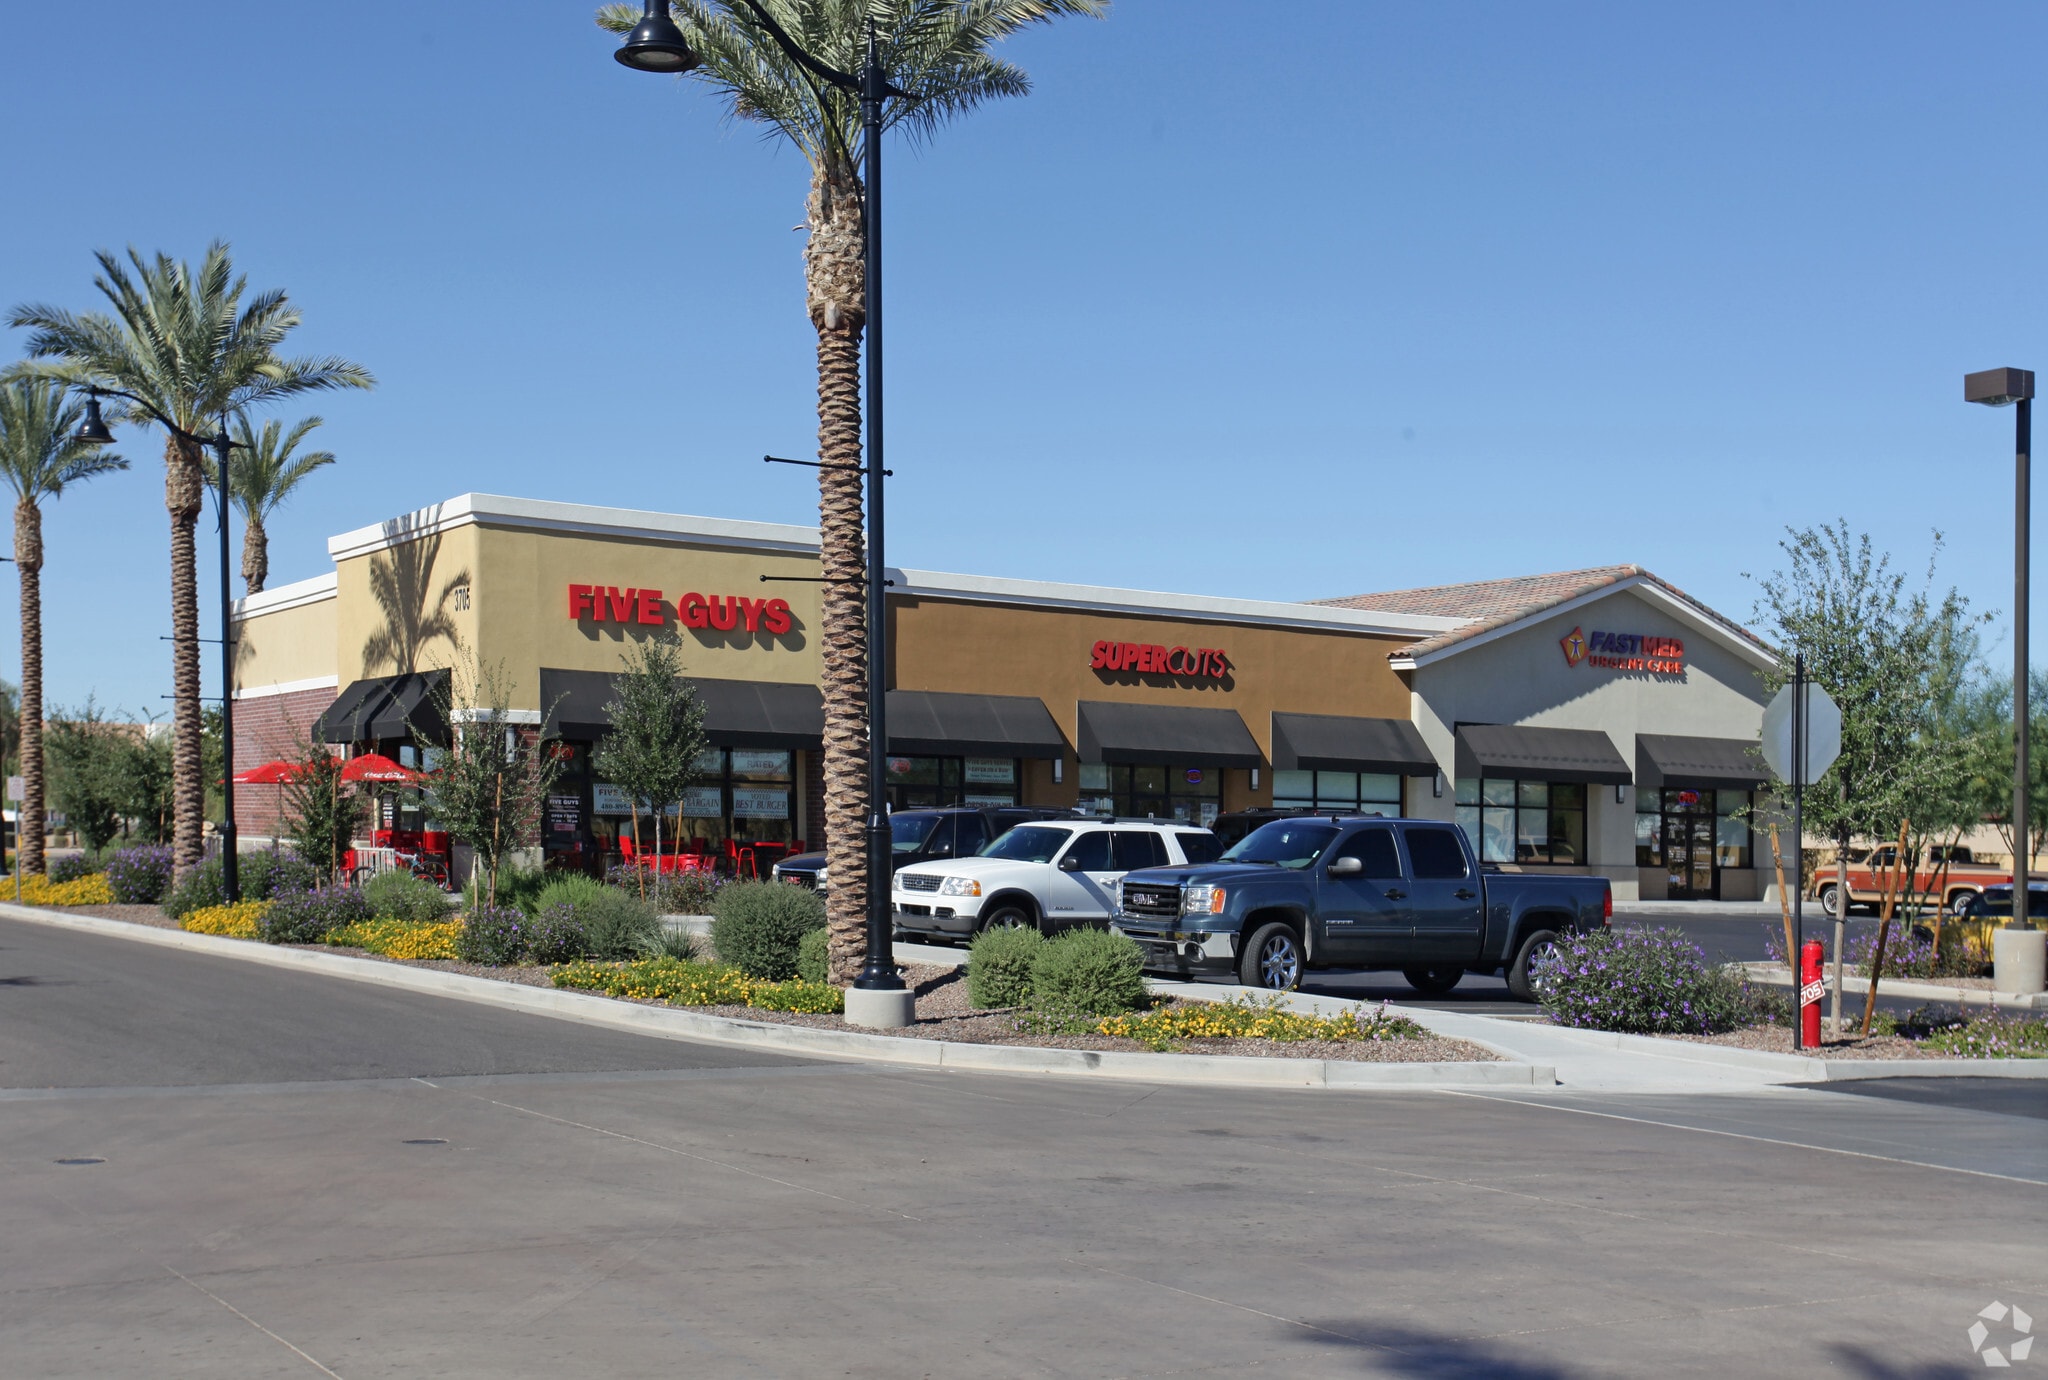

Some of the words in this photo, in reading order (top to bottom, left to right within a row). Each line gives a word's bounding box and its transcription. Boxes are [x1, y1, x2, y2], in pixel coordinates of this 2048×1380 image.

[455, 587, 470, 611] 3705
[568, 584, 664, 625] FIVE
[678, 592, 792, 634] GUYS
[1589, 631, 1684, 658] FASTMED
[1091, 640, 1226, 678] SUPERCUTS
[1589, 655, 1645, 671] URGENT
[1647, 659, 1682, 674] CARE
[686, 798, 719, 808] BARGAIN
[735, 800, 753, 809] BEST
[756, 800, 786, 810] BURGER
[1133, 893, 1159, 906] GMC
[1800, 983, 1821, 1005] 705
